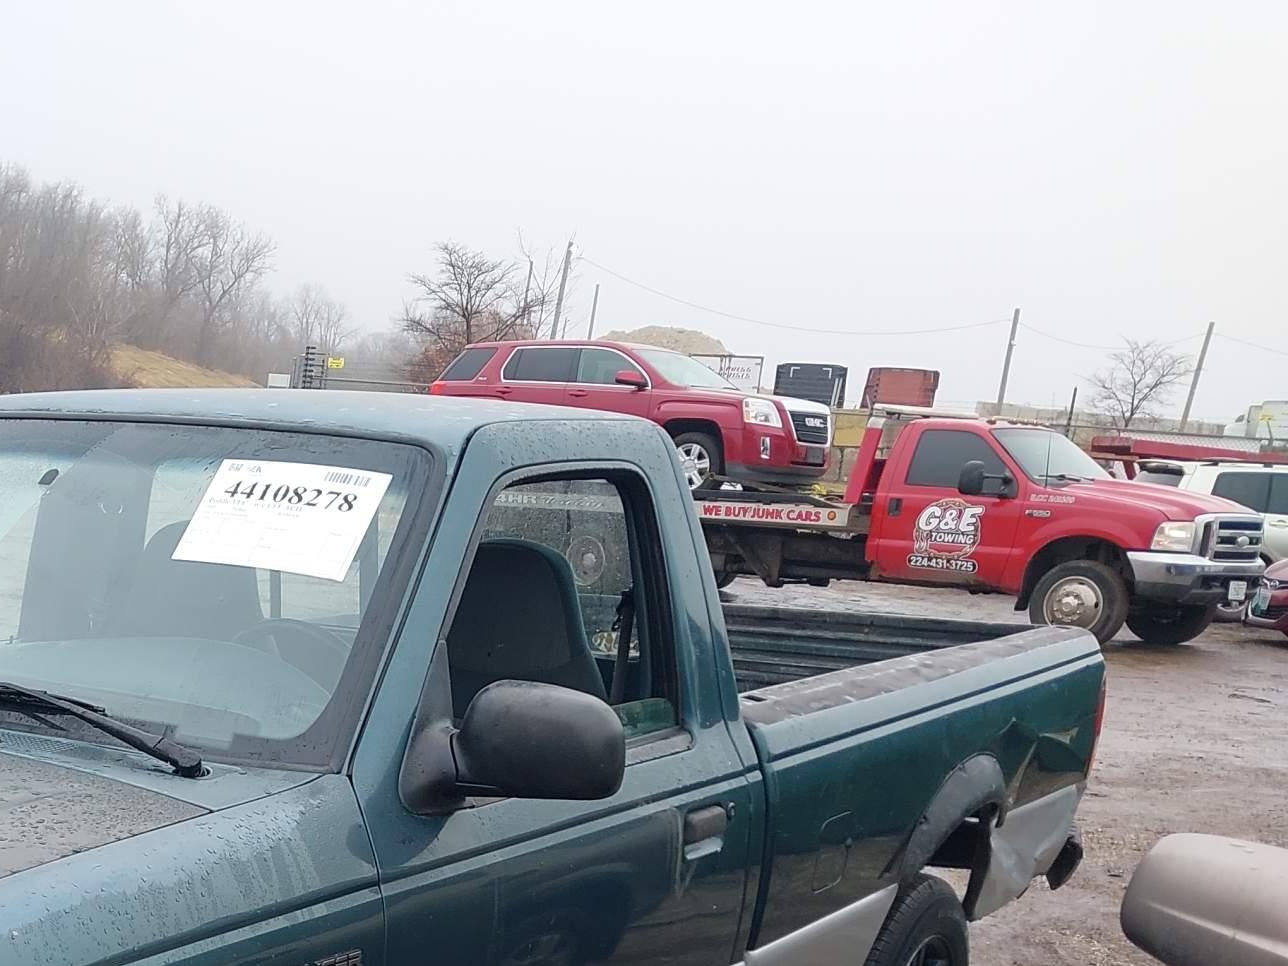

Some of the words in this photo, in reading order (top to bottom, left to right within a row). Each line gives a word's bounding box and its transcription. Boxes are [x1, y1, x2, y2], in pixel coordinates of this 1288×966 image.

[224, 480, 358, 513] 44108278
[702, 504, 722, 517] WE
[724, 505, 749, 519] BUY
[751, 506, 784, 521] JUNK
[786, 509, 822, 523] CARS
[918, 505, 984, 532] G&E
[931, 532, 974, 545] TOWING
